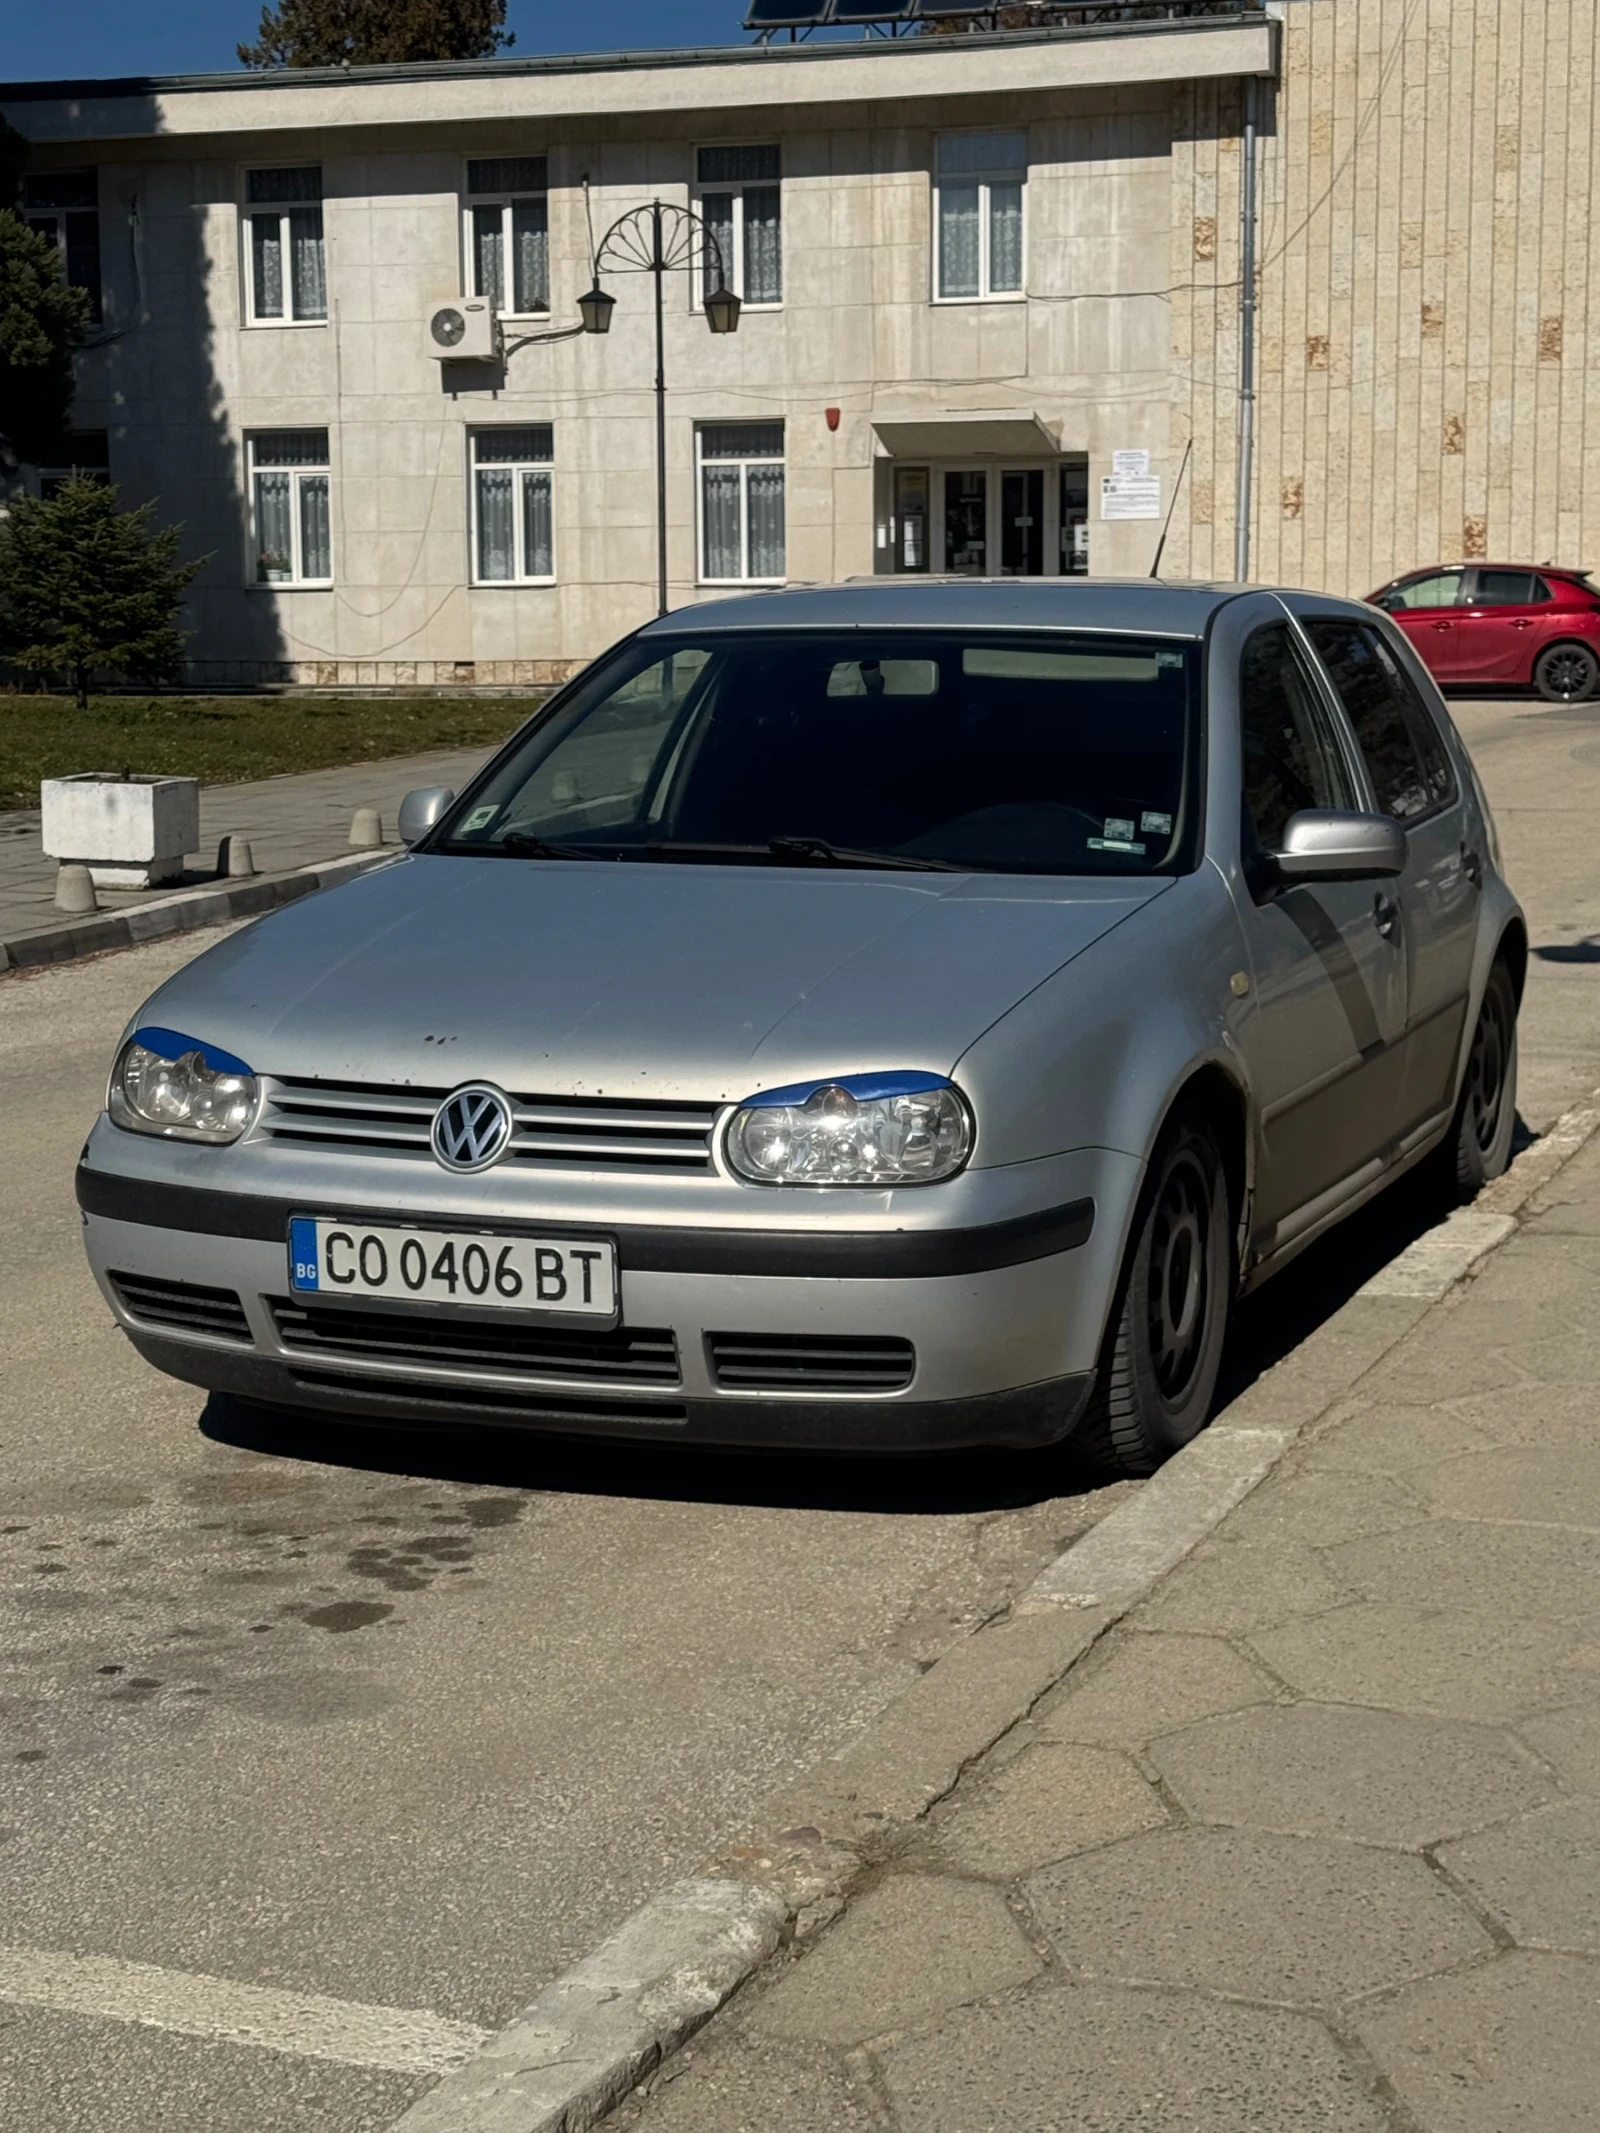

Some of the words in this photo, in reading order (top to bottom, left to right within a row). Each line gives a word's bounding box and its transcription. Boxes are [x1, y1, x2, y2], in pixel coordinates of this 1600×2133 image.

[296, 1262, 317, 1280] BG
[325, 1231, 388, 1287] CO
[399, 1238, 524, 1299] 0406
[534, 1247, 602, 1305] BT
